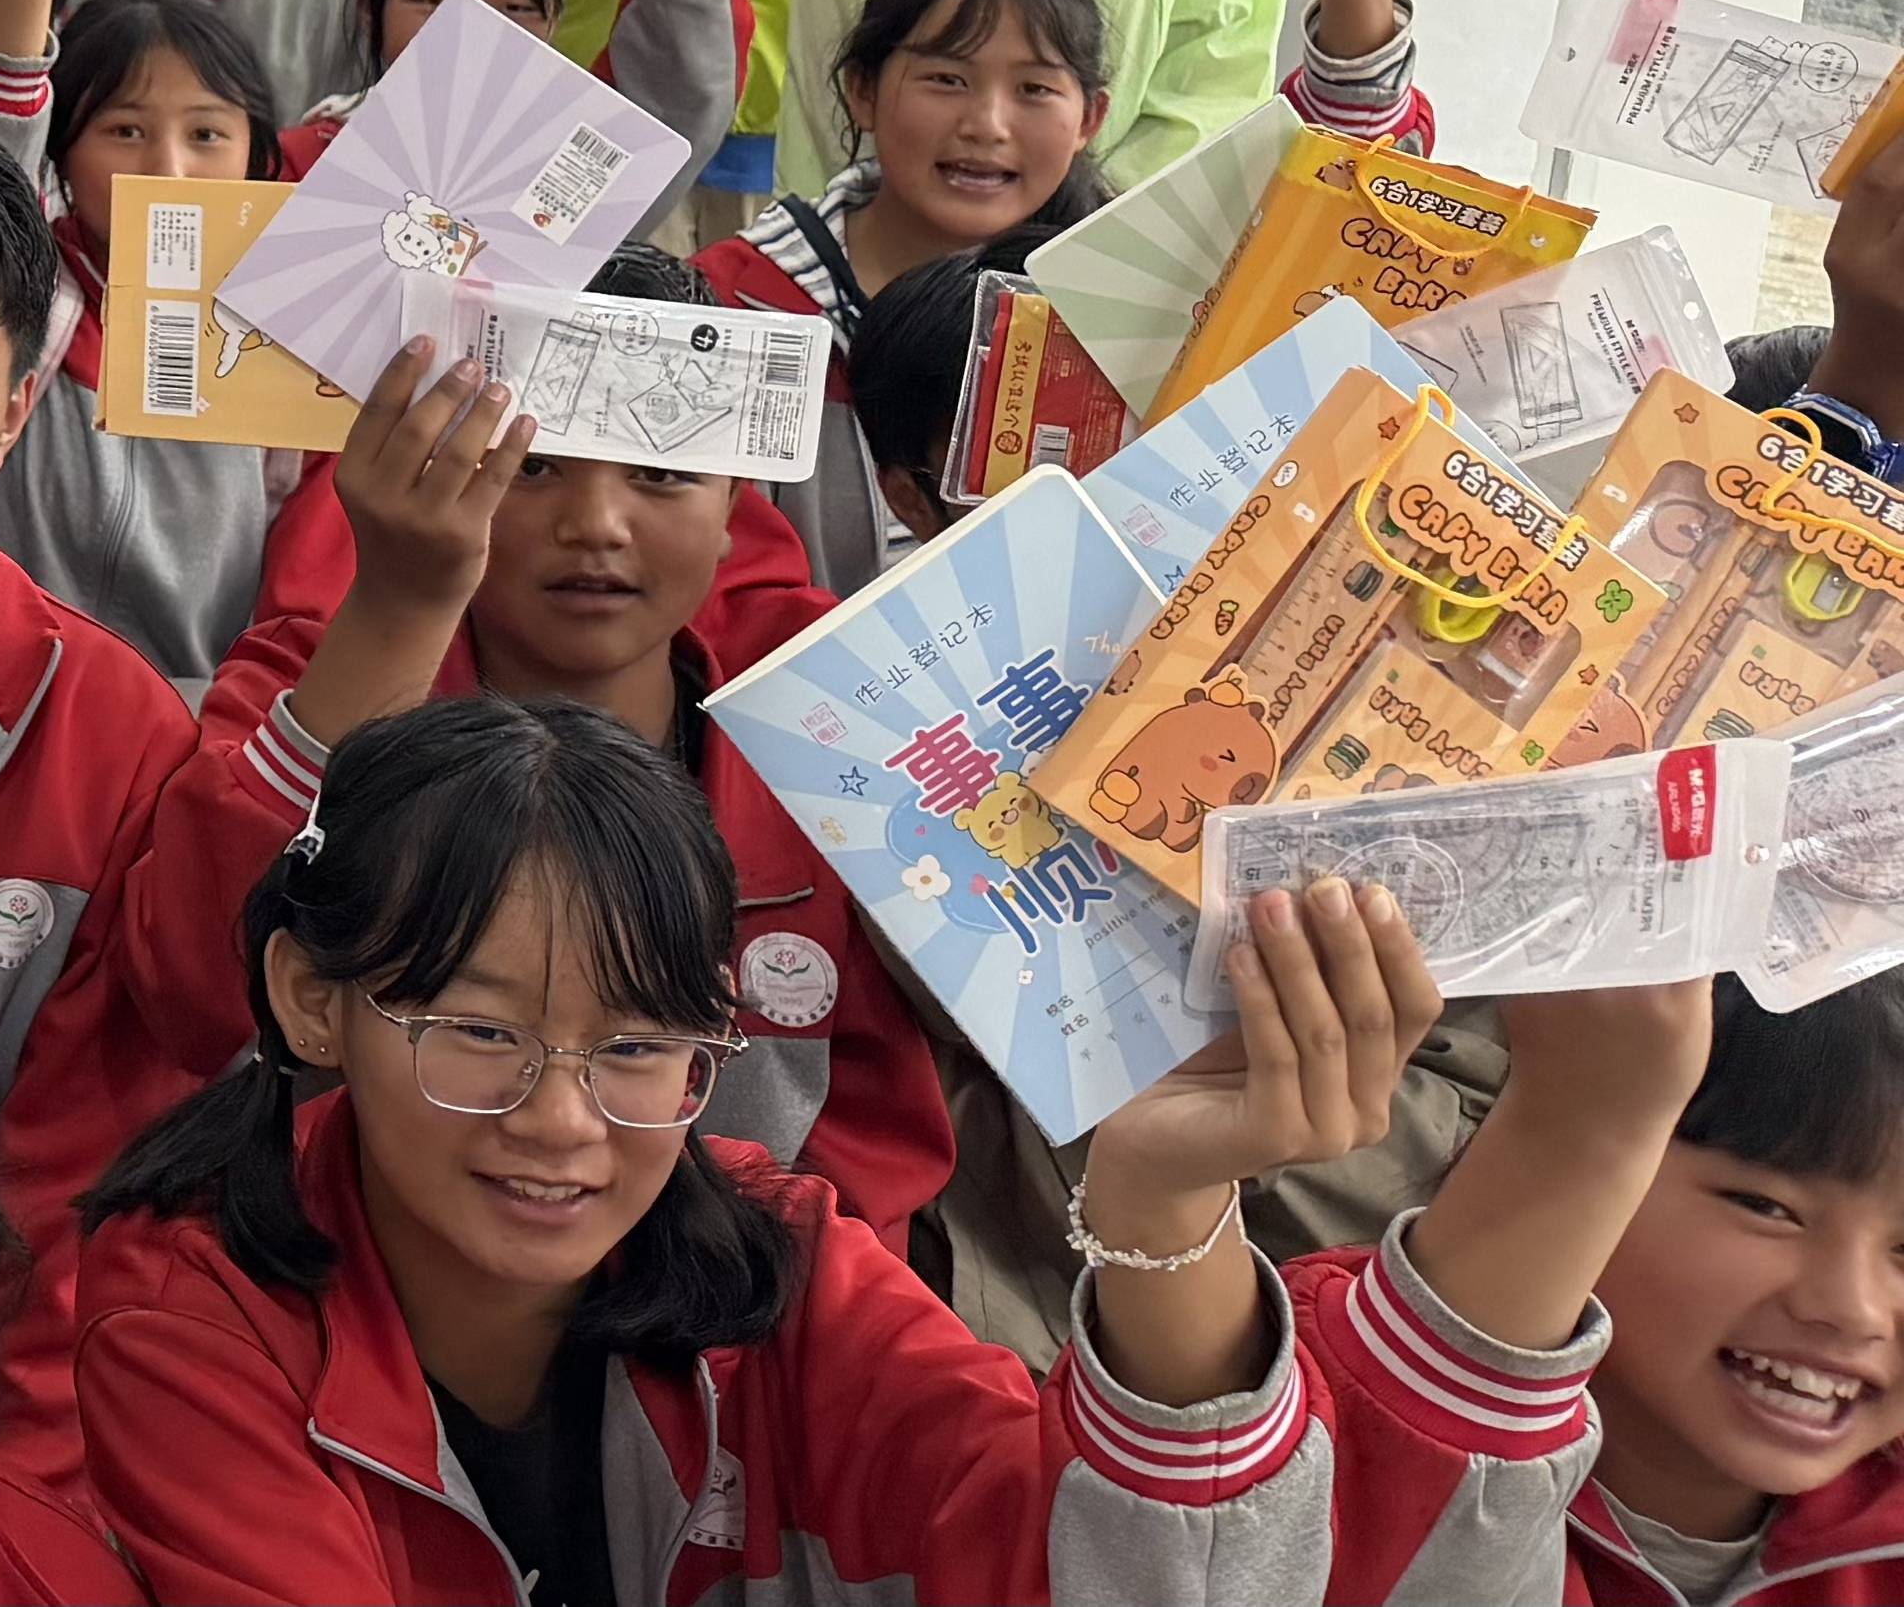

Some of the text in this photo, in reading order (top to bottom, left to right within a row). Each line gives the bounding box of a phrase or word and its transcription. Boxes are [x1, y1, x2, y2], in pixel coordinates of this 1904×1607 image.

[1341, 217, 1445, 273] CAPY
[1369, 176, 1507, 236] 6合1学习套装
[1169, 413, 1297, 508] 作业登记本
[1399, 483, 1491, 568] CAPY
[1443, 449, 1590, 572] 6合1学习套装
[1150, 494, 1271, 641] CAPY BARA
[854, 602, 995, 708] 作业登记本
[1084, 635, 1129, 657] Tha
[1296, 613, 1345, 672] BARA
[883, 648, 1093, 816] 事事
[982, 837, 1119, 955] 顺
[1085, 909, 1139, 950] positive
